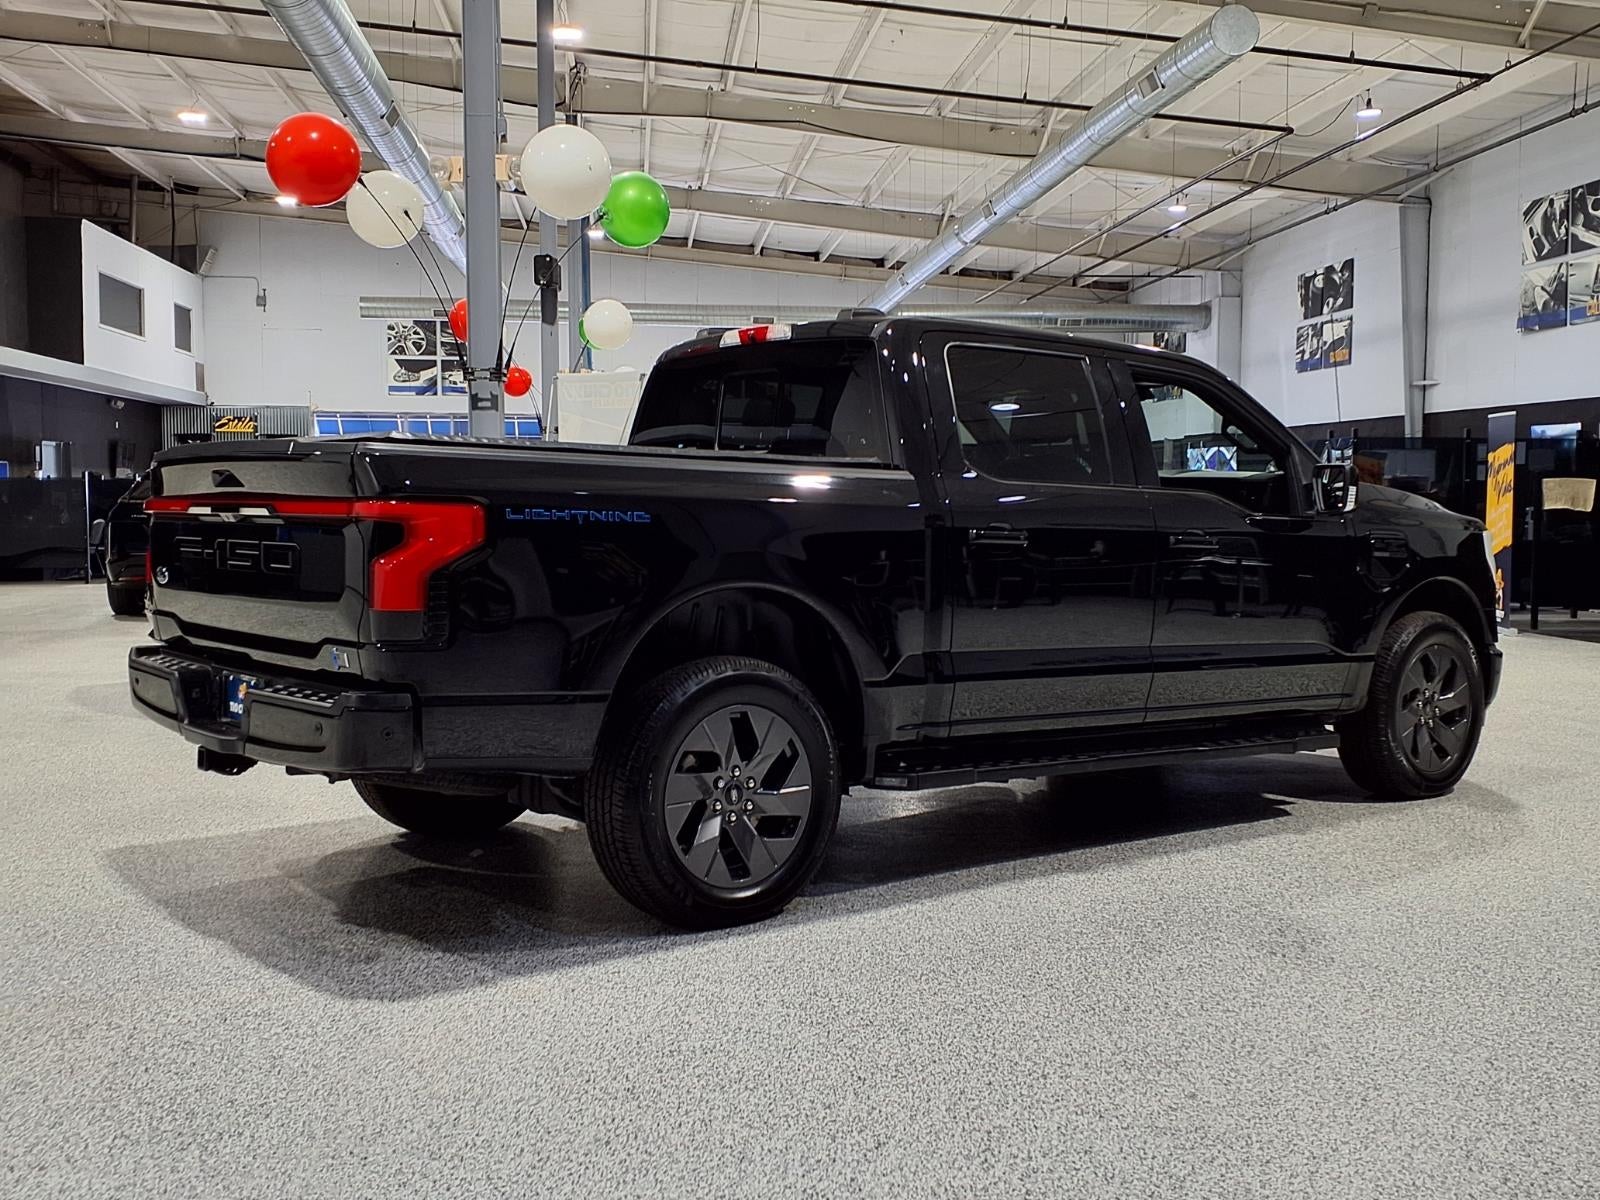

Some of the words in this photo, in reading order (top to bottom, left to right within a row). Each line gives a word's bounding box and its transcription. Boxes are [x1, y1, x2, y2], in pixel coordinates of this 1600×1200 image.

[215, 415, 257, 432] Estilo
[505, 508, 651, 525] LIGHTNING
[174, 536, 300, 576] F-150
